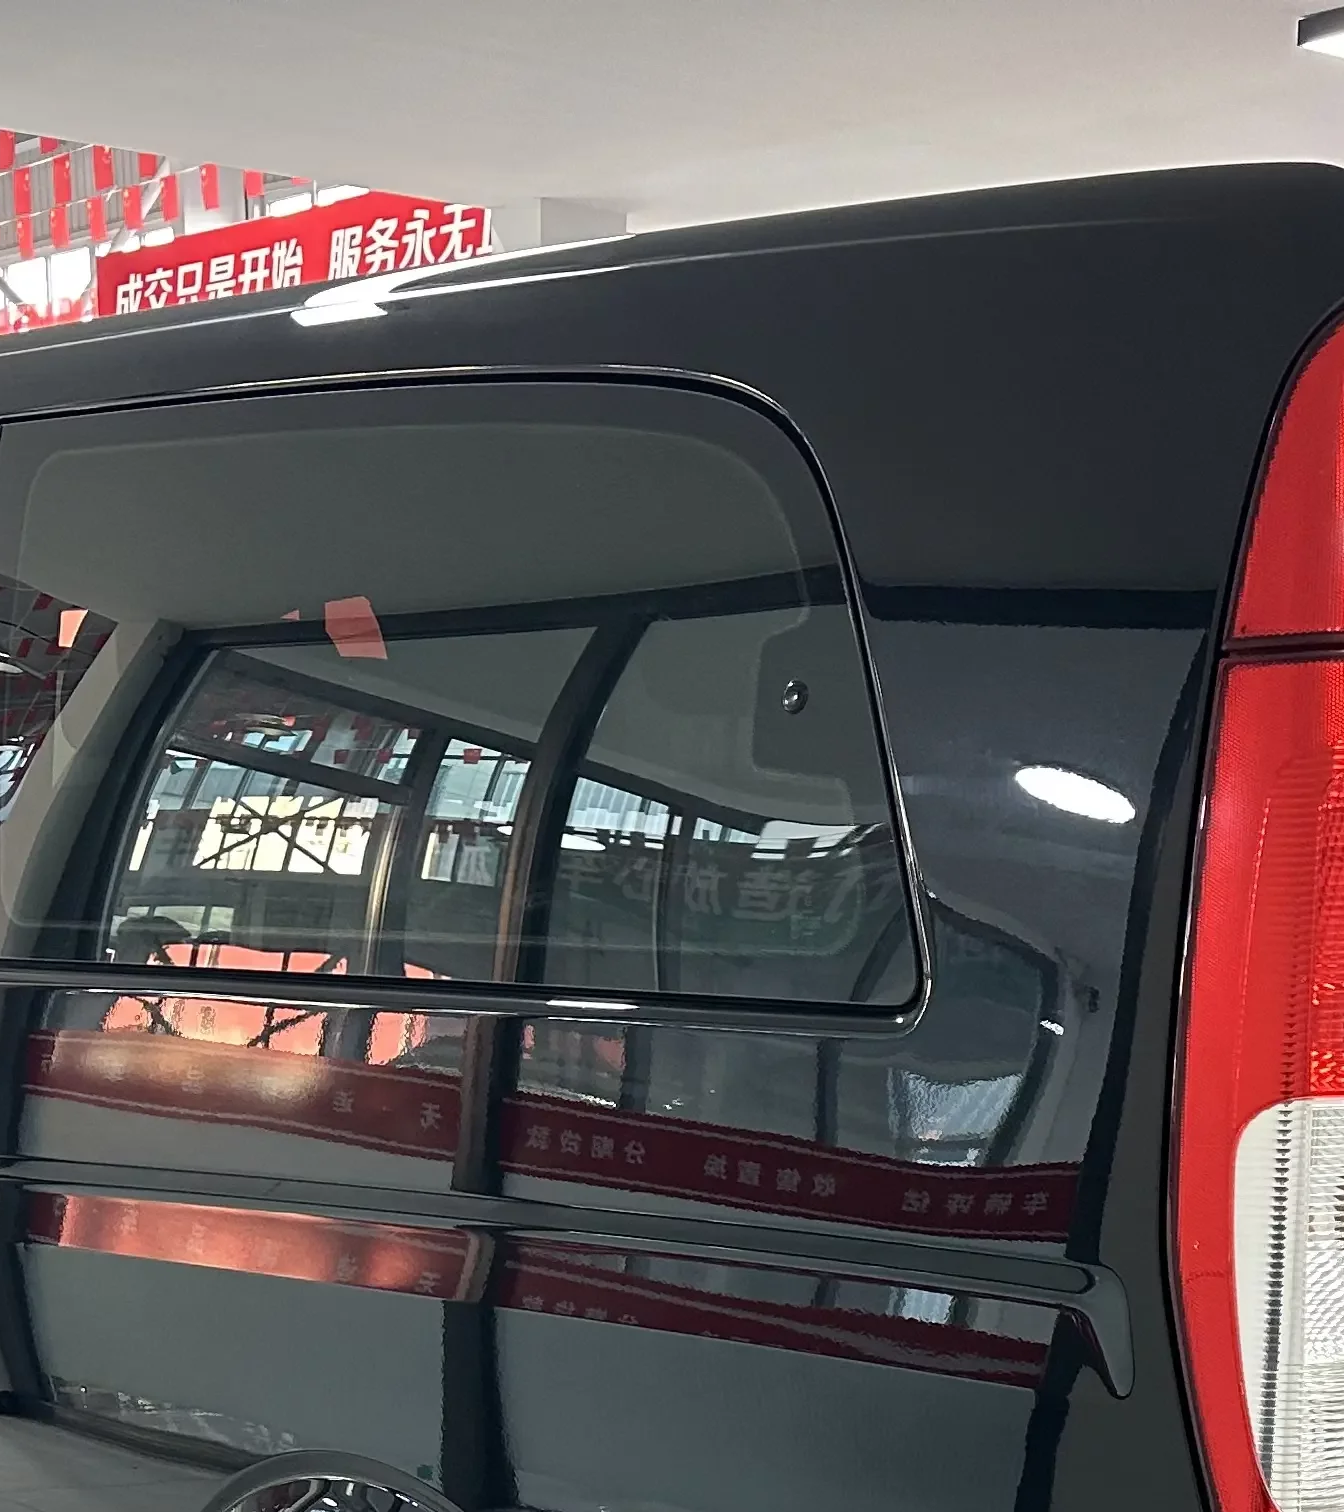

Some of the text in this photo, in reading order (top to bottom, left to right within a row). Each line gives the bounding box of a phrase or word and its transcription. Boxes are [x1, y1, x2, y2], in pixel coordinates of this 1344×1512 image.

[115, 237, 304, 314] 成交只是开始
